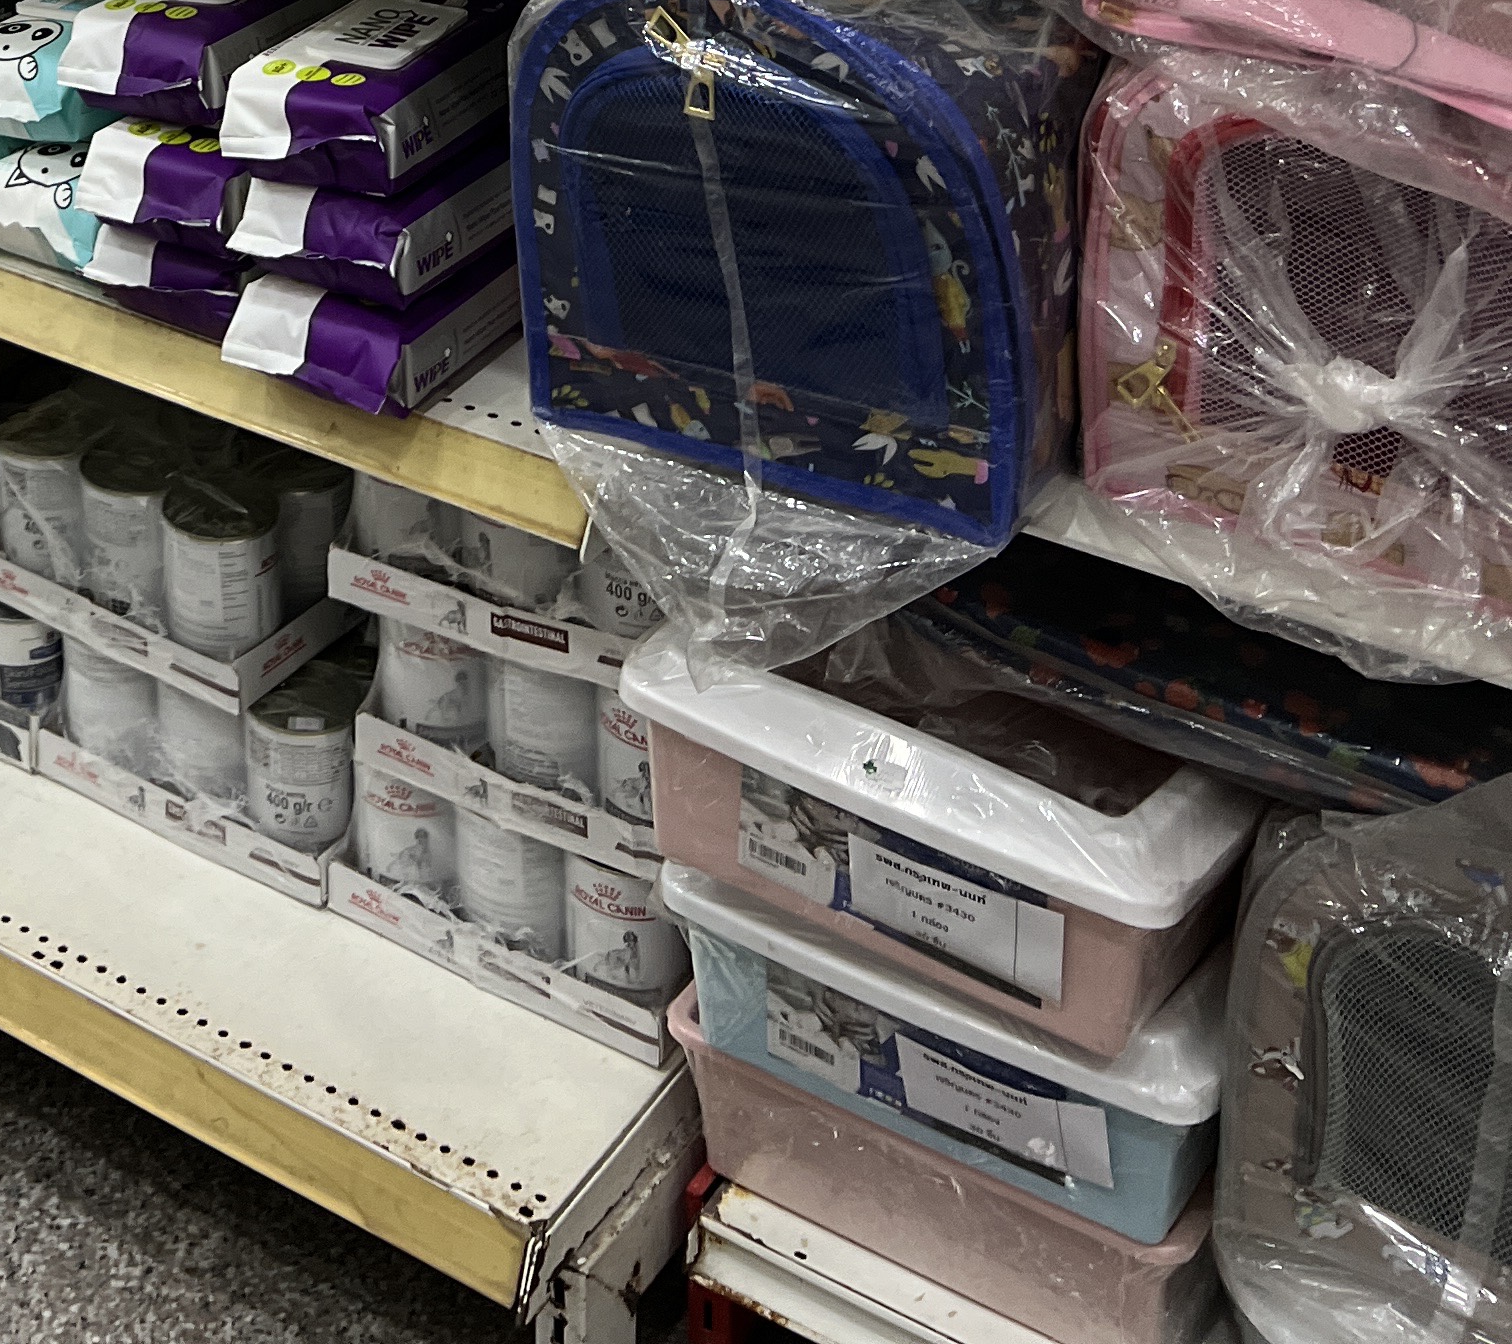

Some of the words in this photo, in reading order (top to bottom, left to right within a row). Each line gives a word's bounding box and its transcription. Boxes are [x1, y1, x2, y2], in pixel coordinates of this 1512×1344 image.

[334, 8, 402, 45] NANO
[368, 10, 439, 50] WIPE
[400, 127, 435, 159] WIPE
[415, 240, 454, 277] WIPE
[412, 358, 450, 393] WIPE
[606, 580, 632, 601] 400
[492, 615, 567, 645] GASTROINTESTINAL
[266, 789, 289, 809] 400
[575, 885, 606, 910] ROYAL
[607, 903, 647, 917] CANIN
[937, 902, 975, 922] #3430
